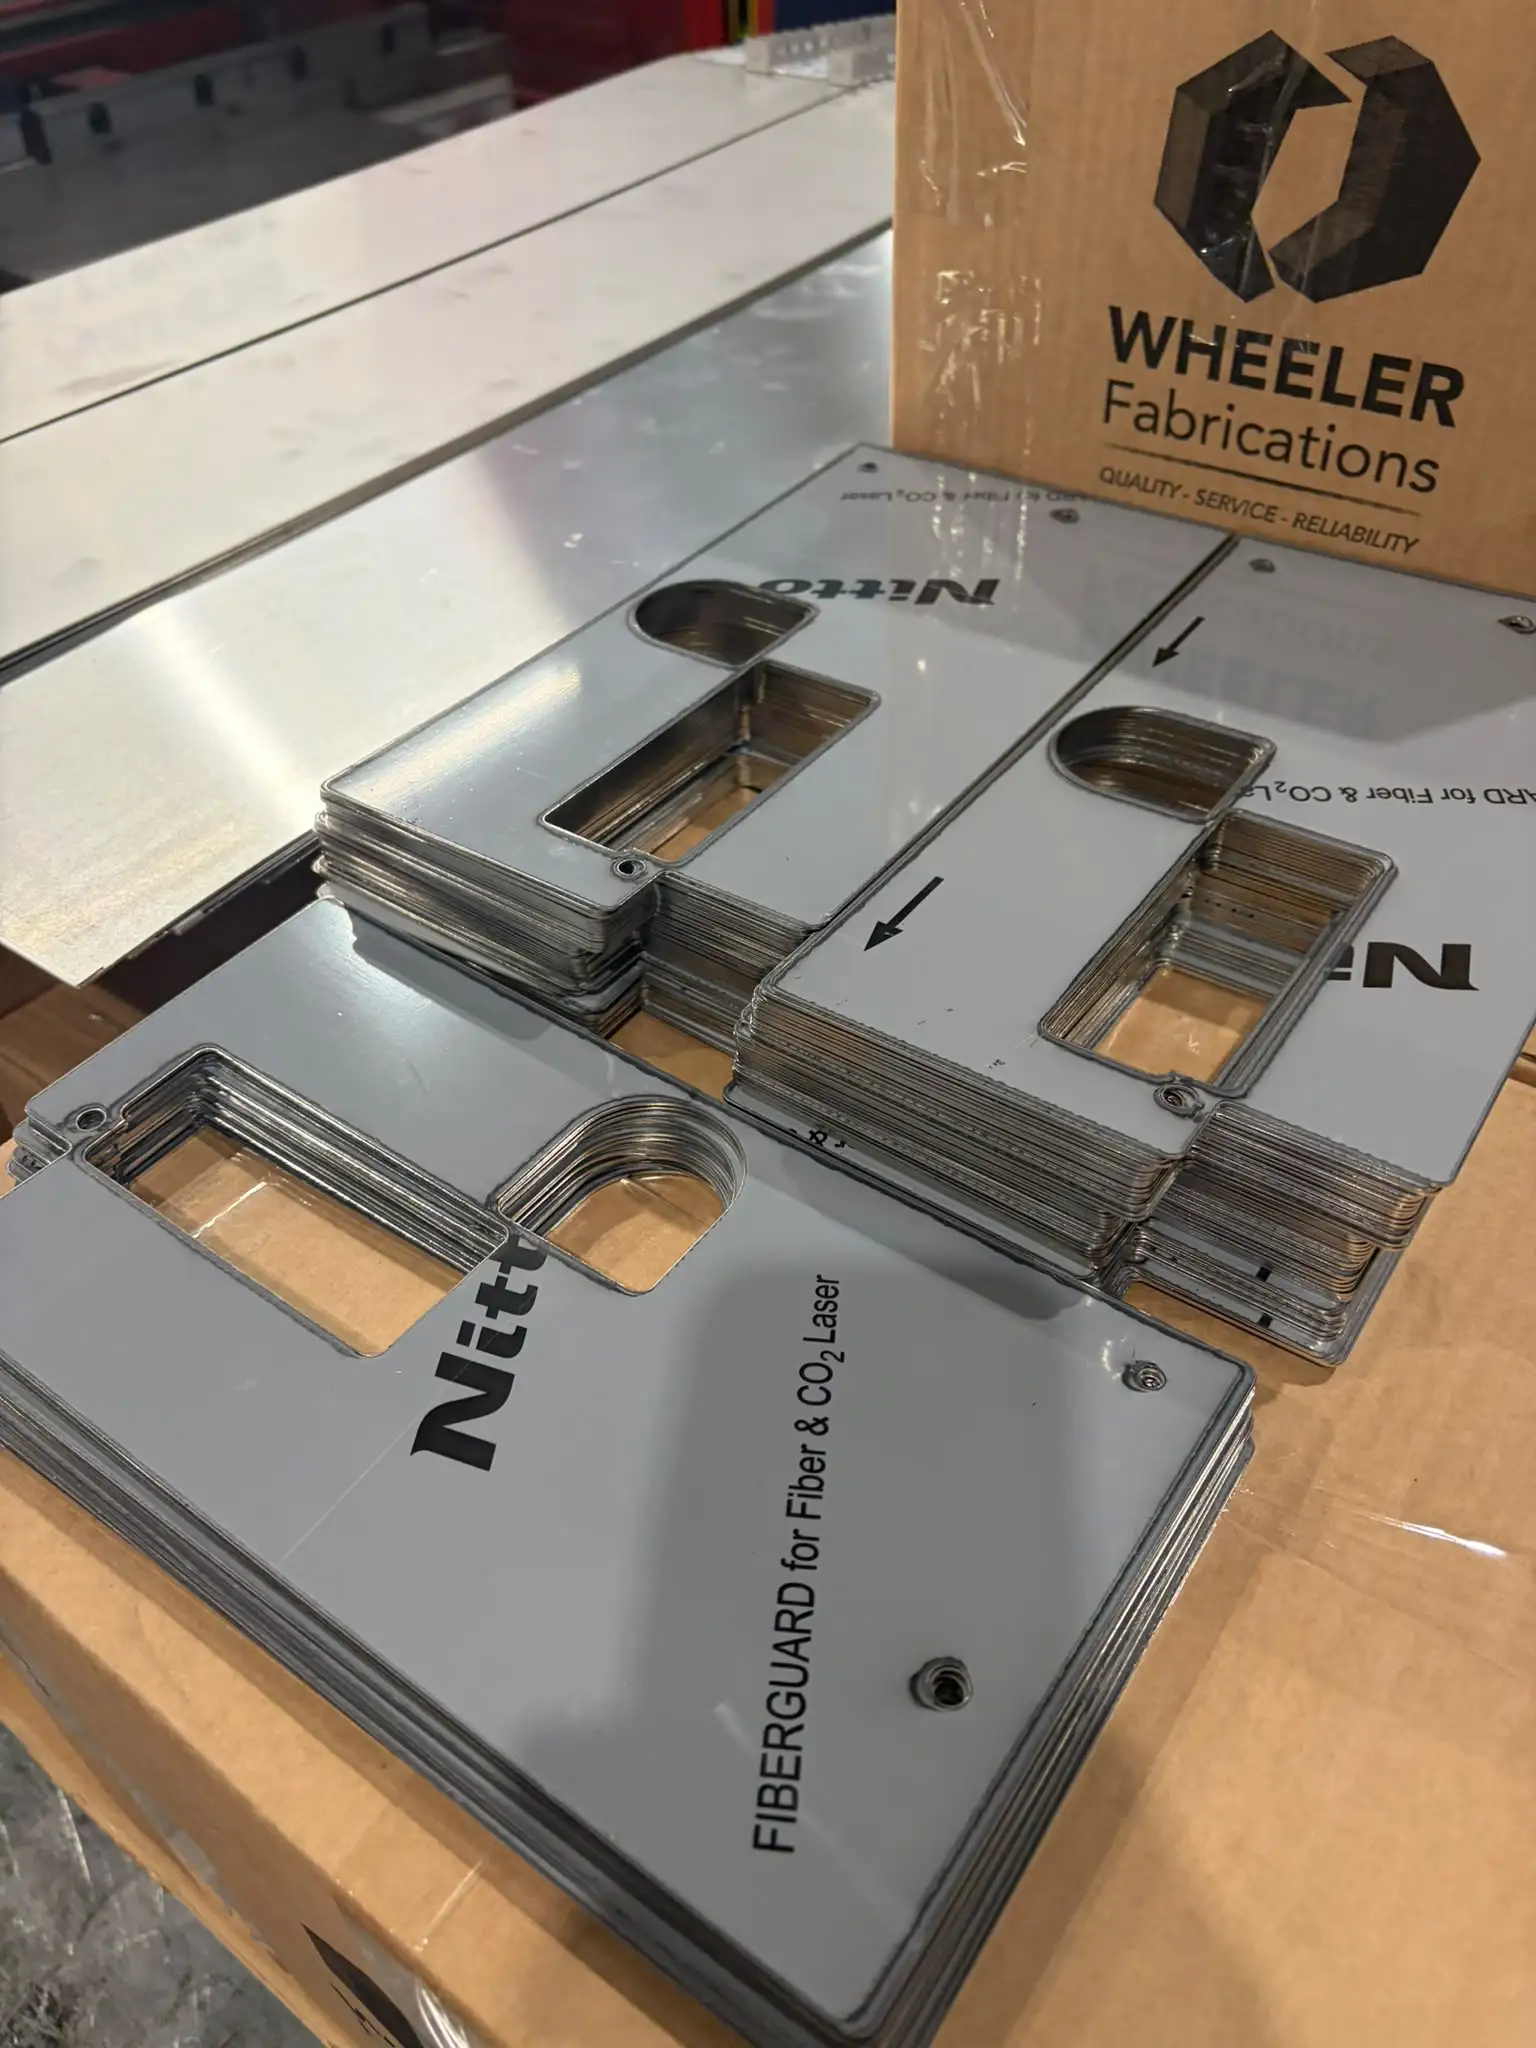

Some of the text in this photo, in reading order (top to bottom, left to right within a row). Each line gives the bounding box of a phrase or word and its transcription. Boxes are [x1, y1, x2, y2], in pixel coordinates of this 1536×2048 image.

[1108, 305, 1465, 428] WHEELER
[1103, 378, 1440, 494] Fabrications
[1099, 466, 1183, 500] QUALITY
[1194, 488, 1280, 525] SERVICE
[1291, 511, 1421, 555] RELIABILITY
[759, 578, 1000, 605] Nitto
[1338, 786, 1357, 802] &
[1366, 787, 1434, 804] Fiber
[1440, 788, 1477, 804] for
[802, 1273, 840, 1344] Laser
[793, 1416, 830, 1436] &
[785, 1443, 827, 1520] Fiber
[780, 1528, 821, 1572] for
[752, 1582, 816, 1854] FIBERGUARD
